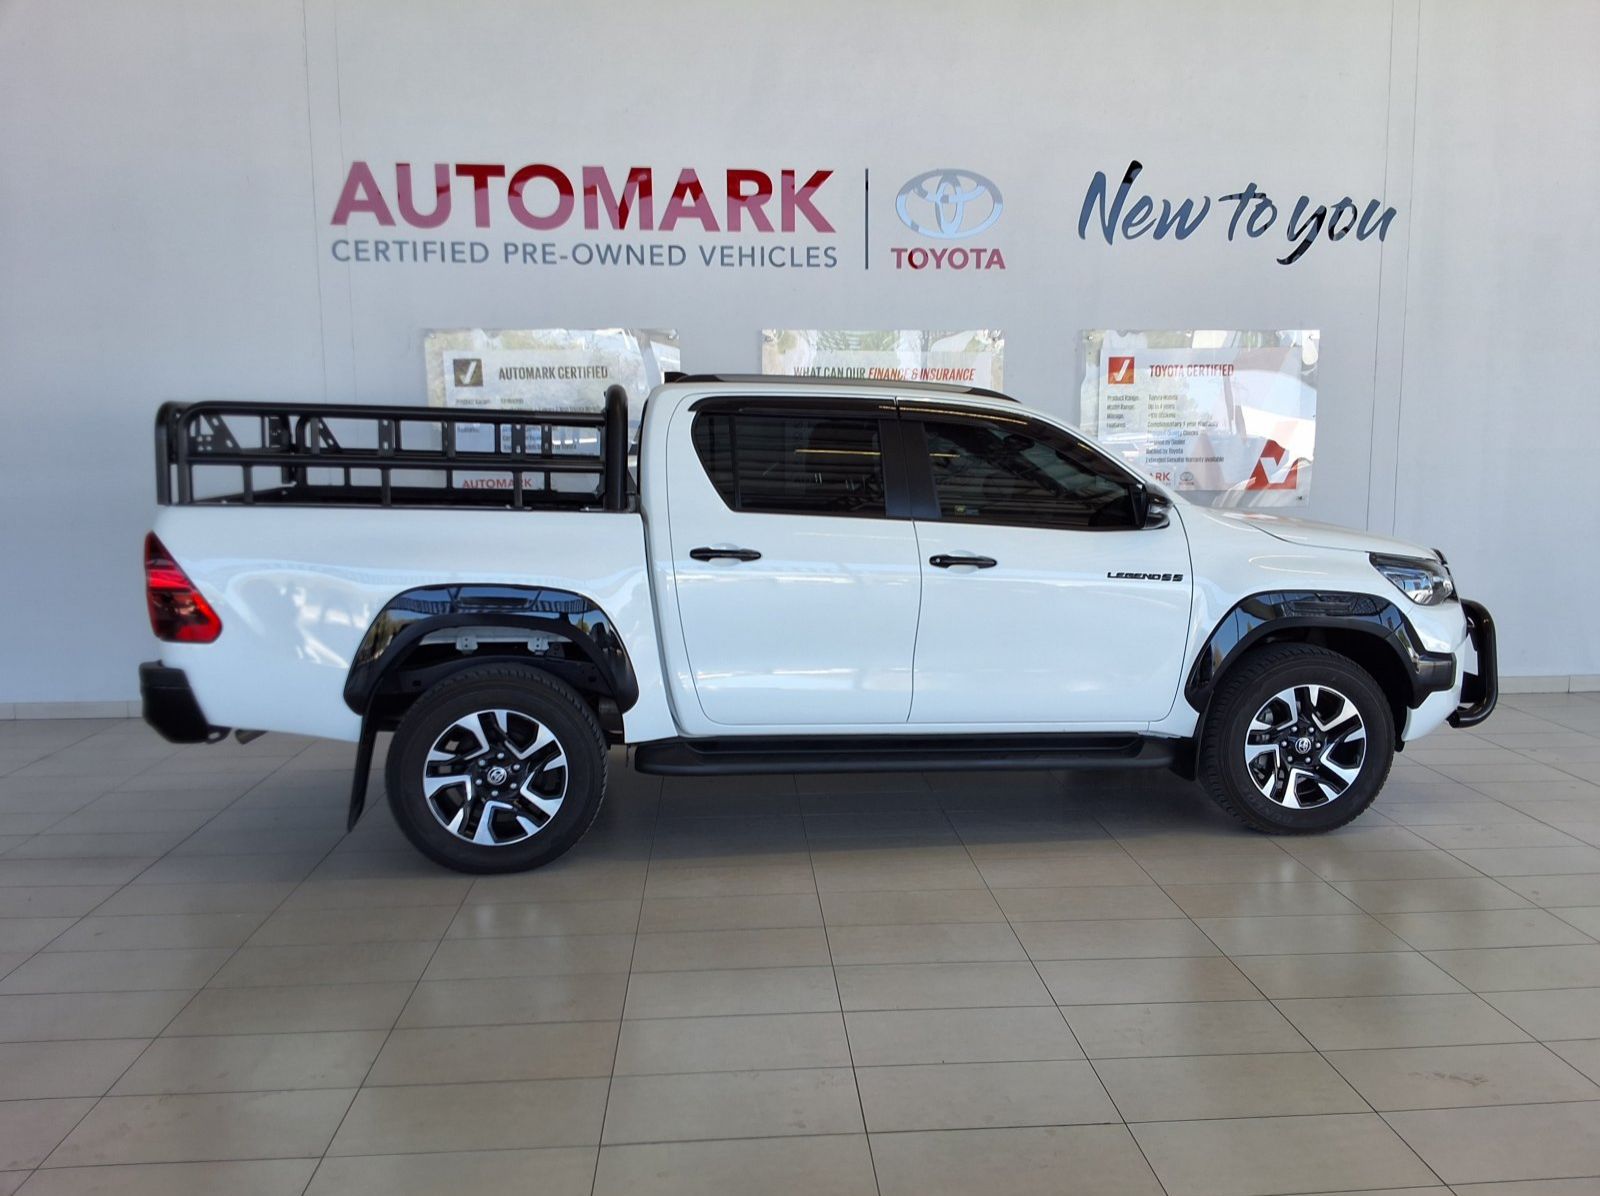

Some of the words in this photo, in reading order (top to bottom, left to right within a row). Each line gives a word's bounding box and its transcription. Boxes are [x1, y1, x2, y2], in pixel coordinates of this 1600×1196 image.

[330, 161, 836, 233] AUTOMARK
[1077, 159, 1211, 246] New
[1276, 195, 1397, 266] you
[331, 240, 490, 263] CERTIFIED
[504, 243, 687, 266] PRE-OWNED
[700, 245, 838, 268] VEHICLES
[890, 247, 1006, 270] TOYOTA
[499, 366, 555, 380] AUTOMARK
[557, 365, 608, 379] CERTIFIED
[794, 366, 822, 377] WHAT
[824, 366, 843, 378] CAN
[846, 367, 866, 379] OUR
[868, 367, 909, 381] FINANCE
[911, 368, 918, 380] &
[919, 367, 976, 381] INSURANCE
[1150, 365, 1184, 377] TOYOTA
[1186, 364, 1235, 377] CERTIFIED
